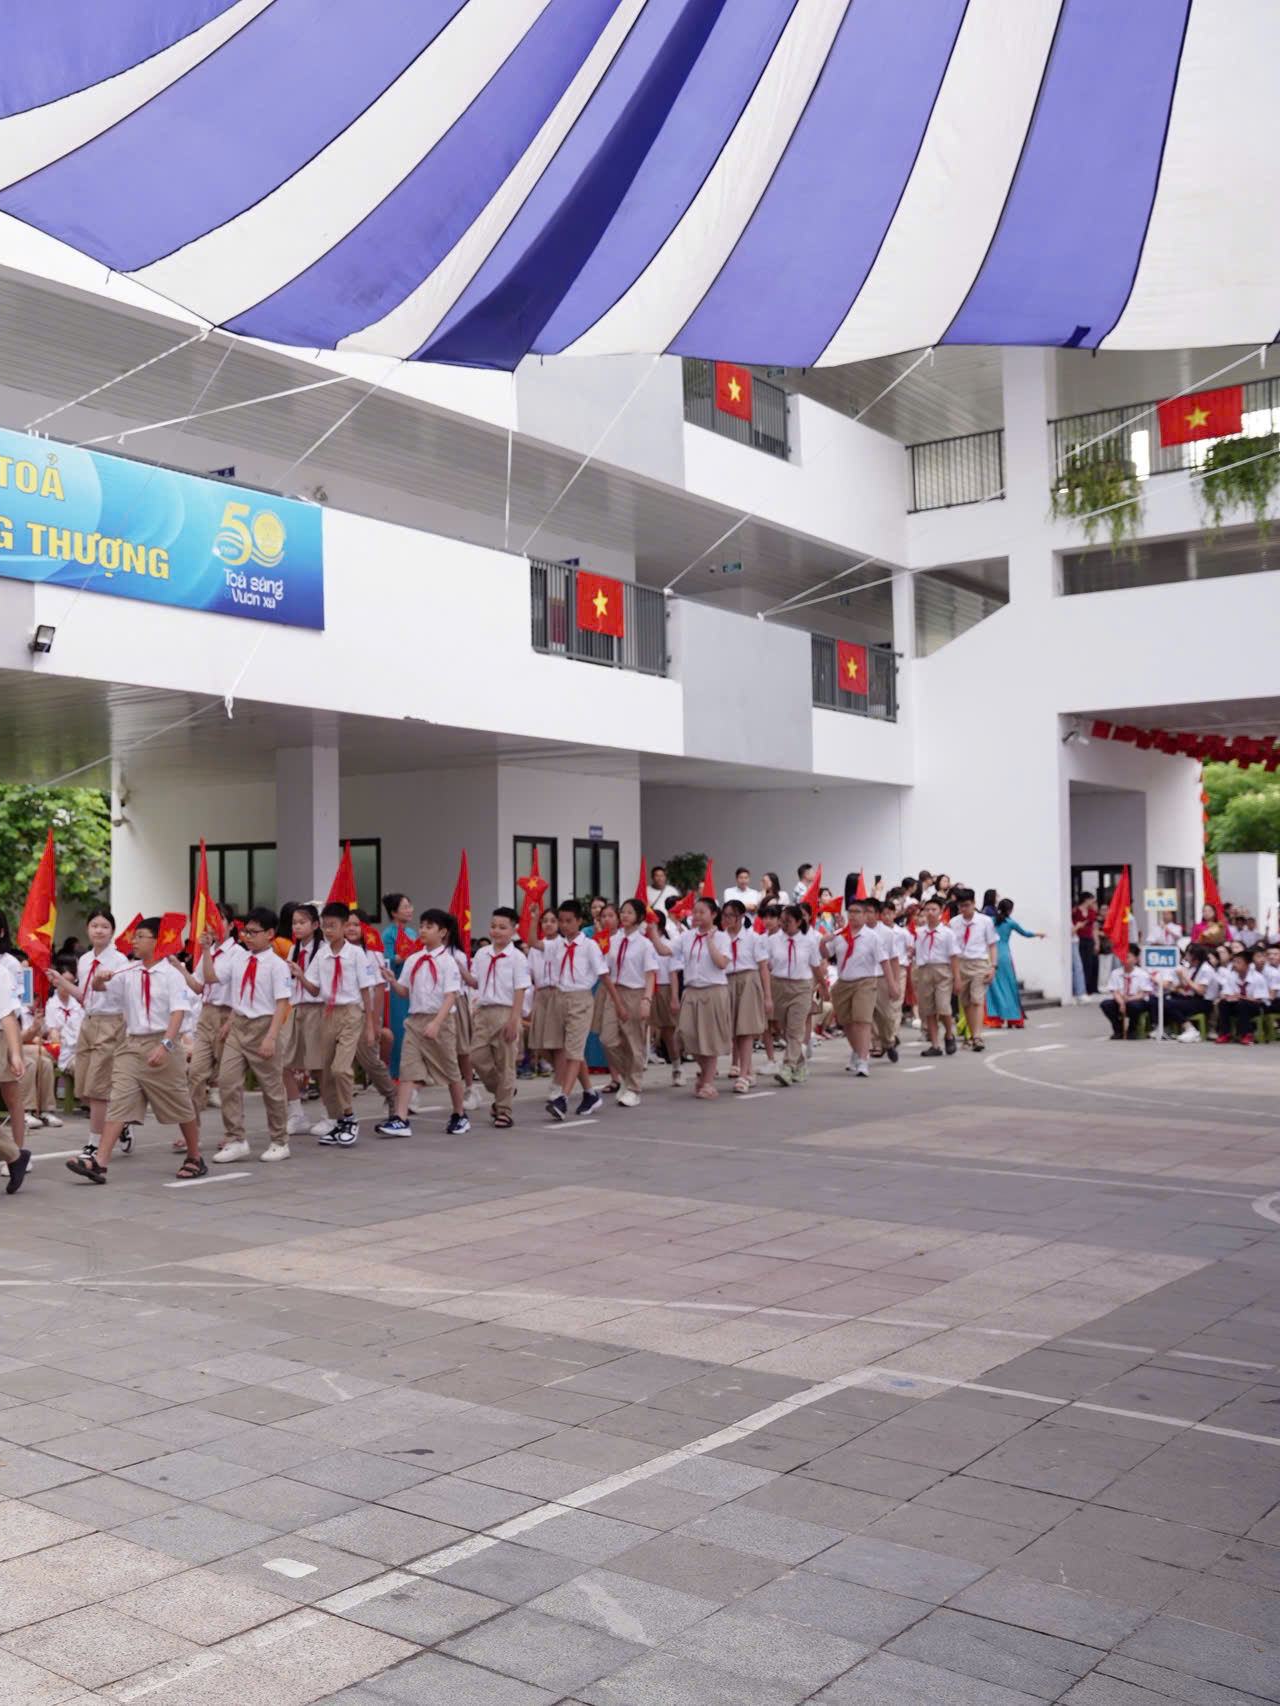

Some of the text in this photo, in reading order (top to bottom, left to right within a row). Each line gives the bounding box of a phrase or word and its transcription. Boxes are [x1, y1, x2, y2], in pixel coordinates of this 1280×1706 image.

[26, 521, 170, 579] THƯỢNG
[212, 501, 287, 567] 50
[250, 576, 284, 600] sáng
[263, 597, 277, 609] xa
